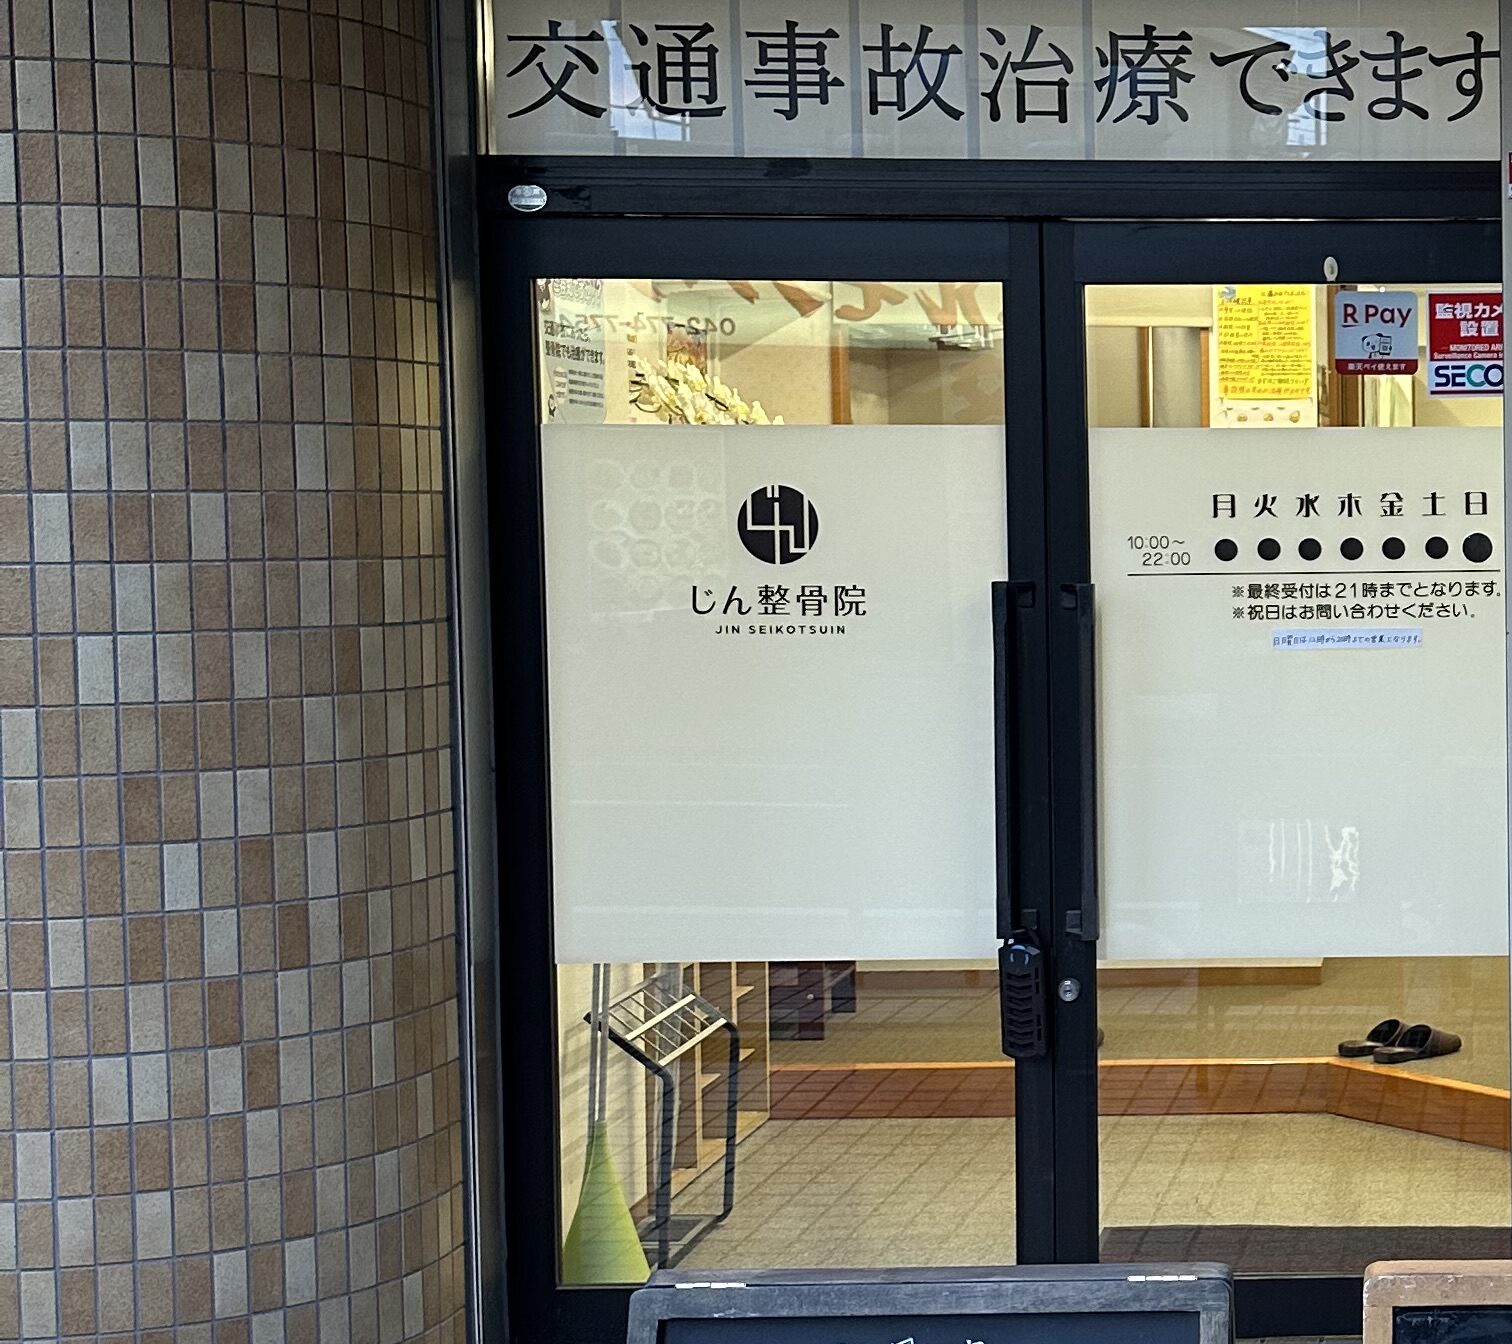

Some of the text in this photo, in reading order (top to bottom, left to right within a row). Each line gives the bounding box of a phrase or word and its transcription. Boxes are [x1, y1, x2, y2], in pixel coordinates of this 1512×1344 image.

[506, 19, 1500, 125] 交通事故治療できます
[1342, 303, 1412, 328] R Pay
[1460, 321, 1499, 336] 設置
[1142, 552, 1191, 566] 22:00
[691, 584, 867, 617] じん整骨院
[715, 625, 846, 635] JIN SEIKOTSUIN
